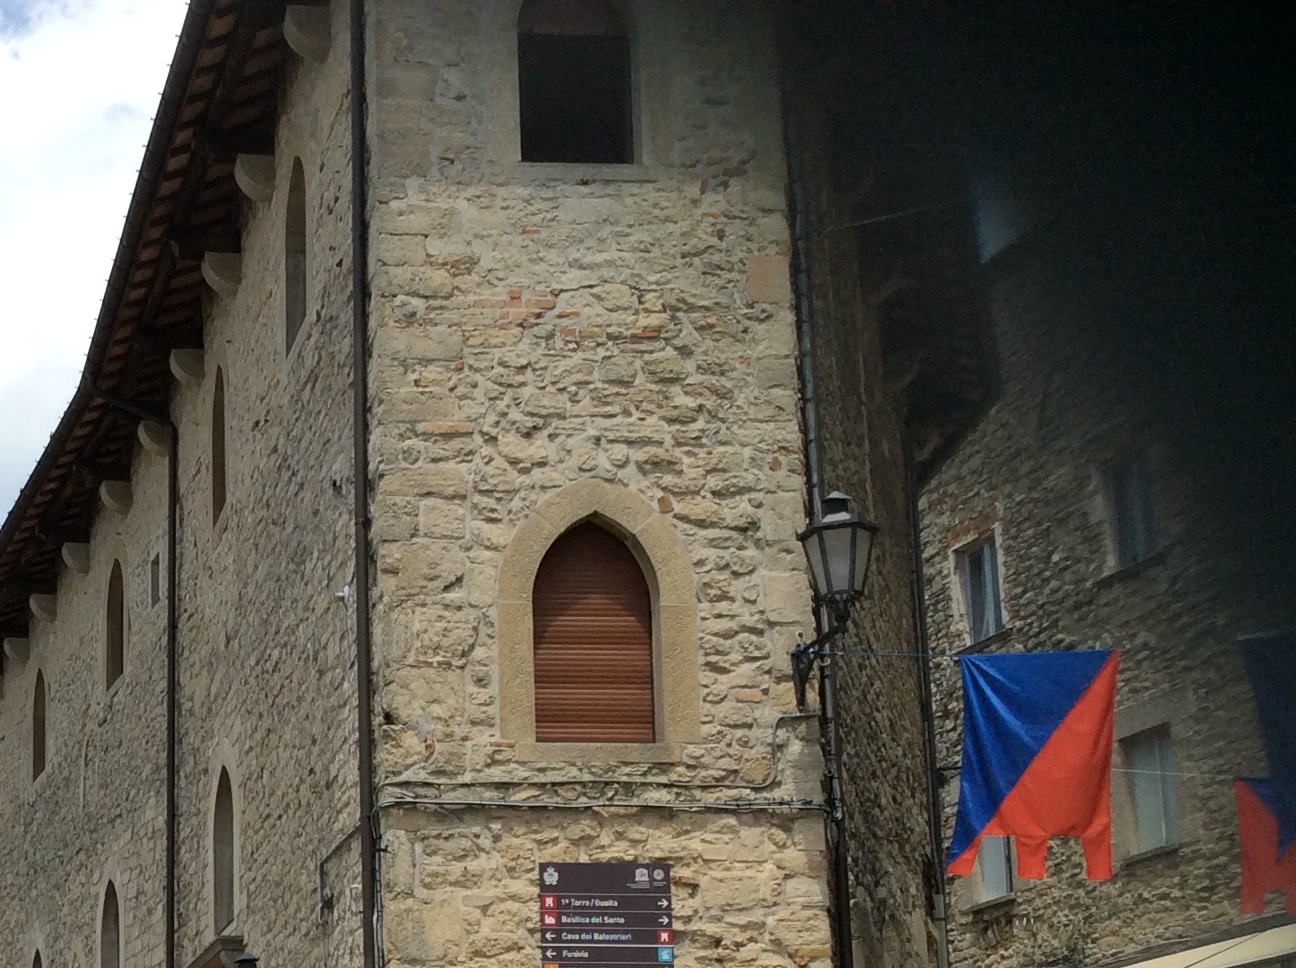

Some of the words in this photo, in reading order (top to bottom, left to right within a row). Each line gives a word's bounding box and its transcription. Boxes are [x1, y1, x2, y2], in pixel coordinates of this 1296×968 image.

[571, 898, 589, 906] Torre
[604, 916, 625, 924] Santo
[561, 932, 580, 940] Cava
[581, 932, 592, 940] dei
[593, 932, 632, 941] Balestrieri
[562, 950, 589, 958] Funivia
